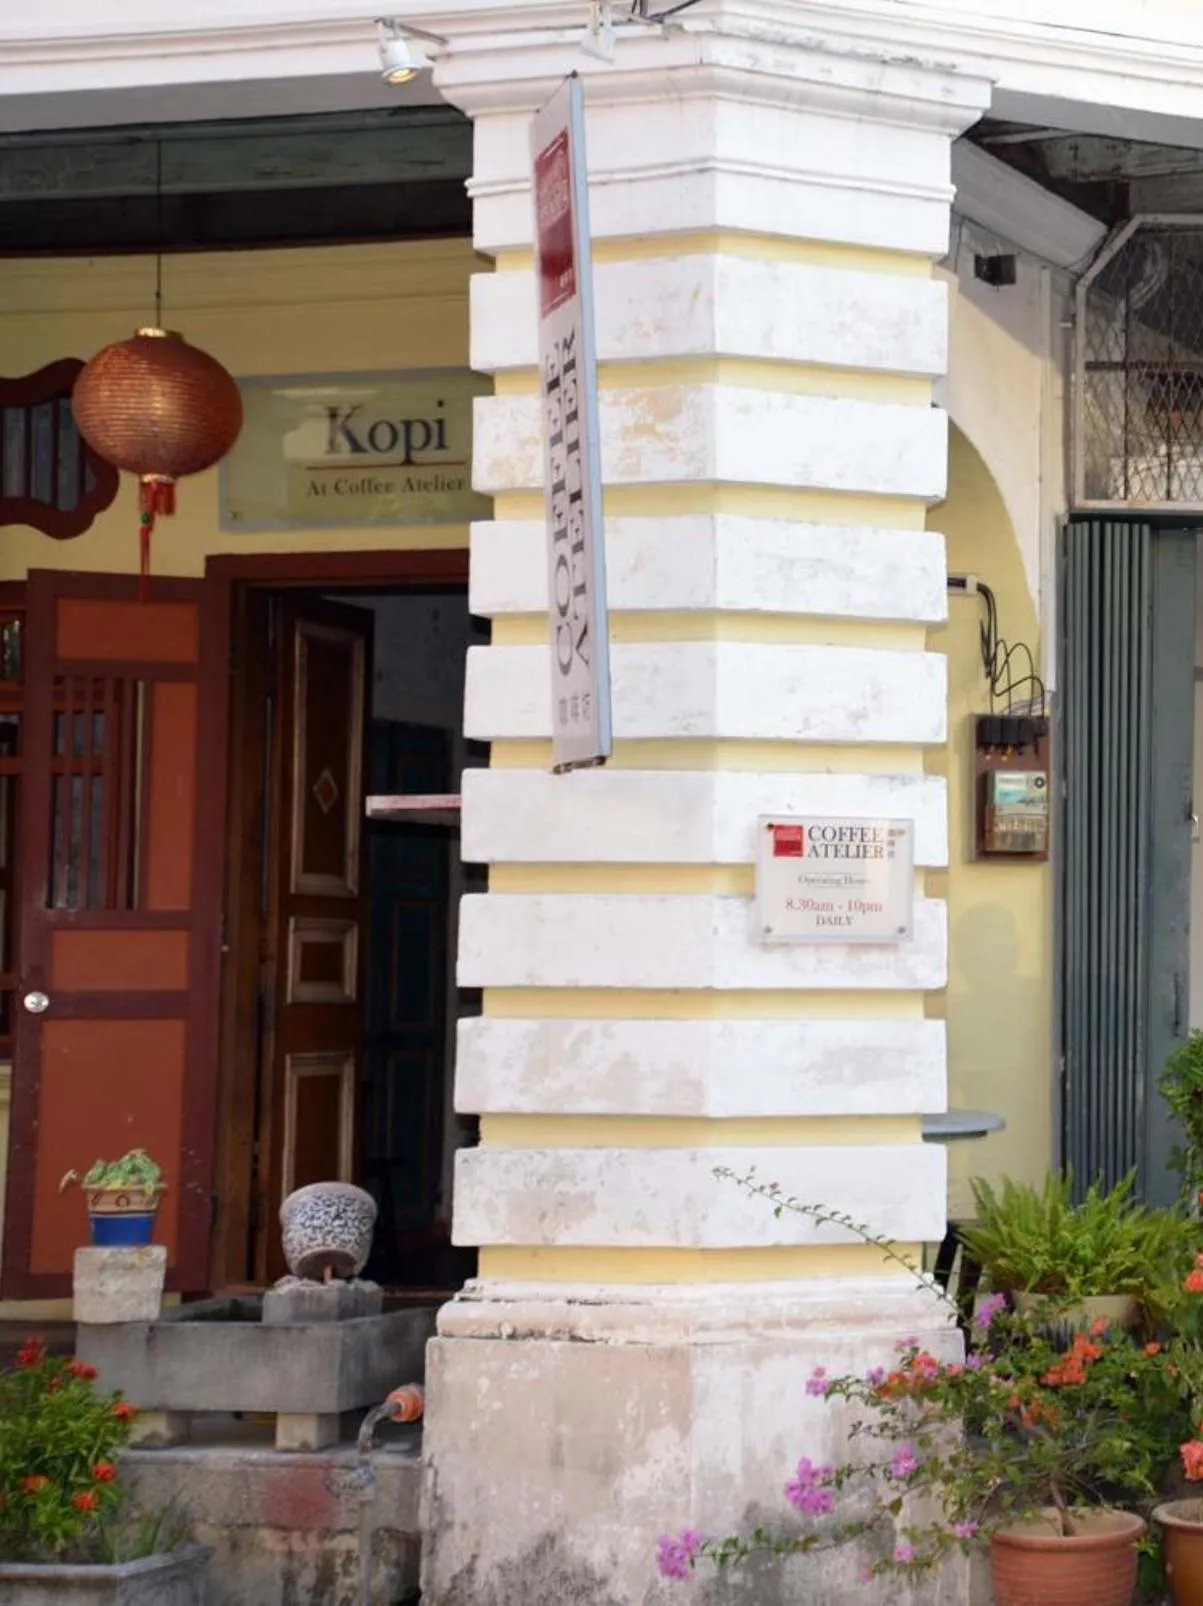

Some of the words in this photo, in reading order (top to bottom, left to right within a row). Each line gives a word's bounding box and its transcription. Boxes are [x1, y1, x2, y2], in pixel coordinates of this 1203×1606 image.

[324, 400, 448, 465] Kopi
[306, 478, 327, 496] At
[334, 476, 395, 496] Coffee
[402, 472, 465, 493] Atelier
[545, 341, 574, 677] COFFEE
[561, 326, 590, 669] ATELIER
[807, 825, 885, 843] COFFEE
[807, 844, 885, 860] ATELIER
[847, 899, 883, 915] 10pm
